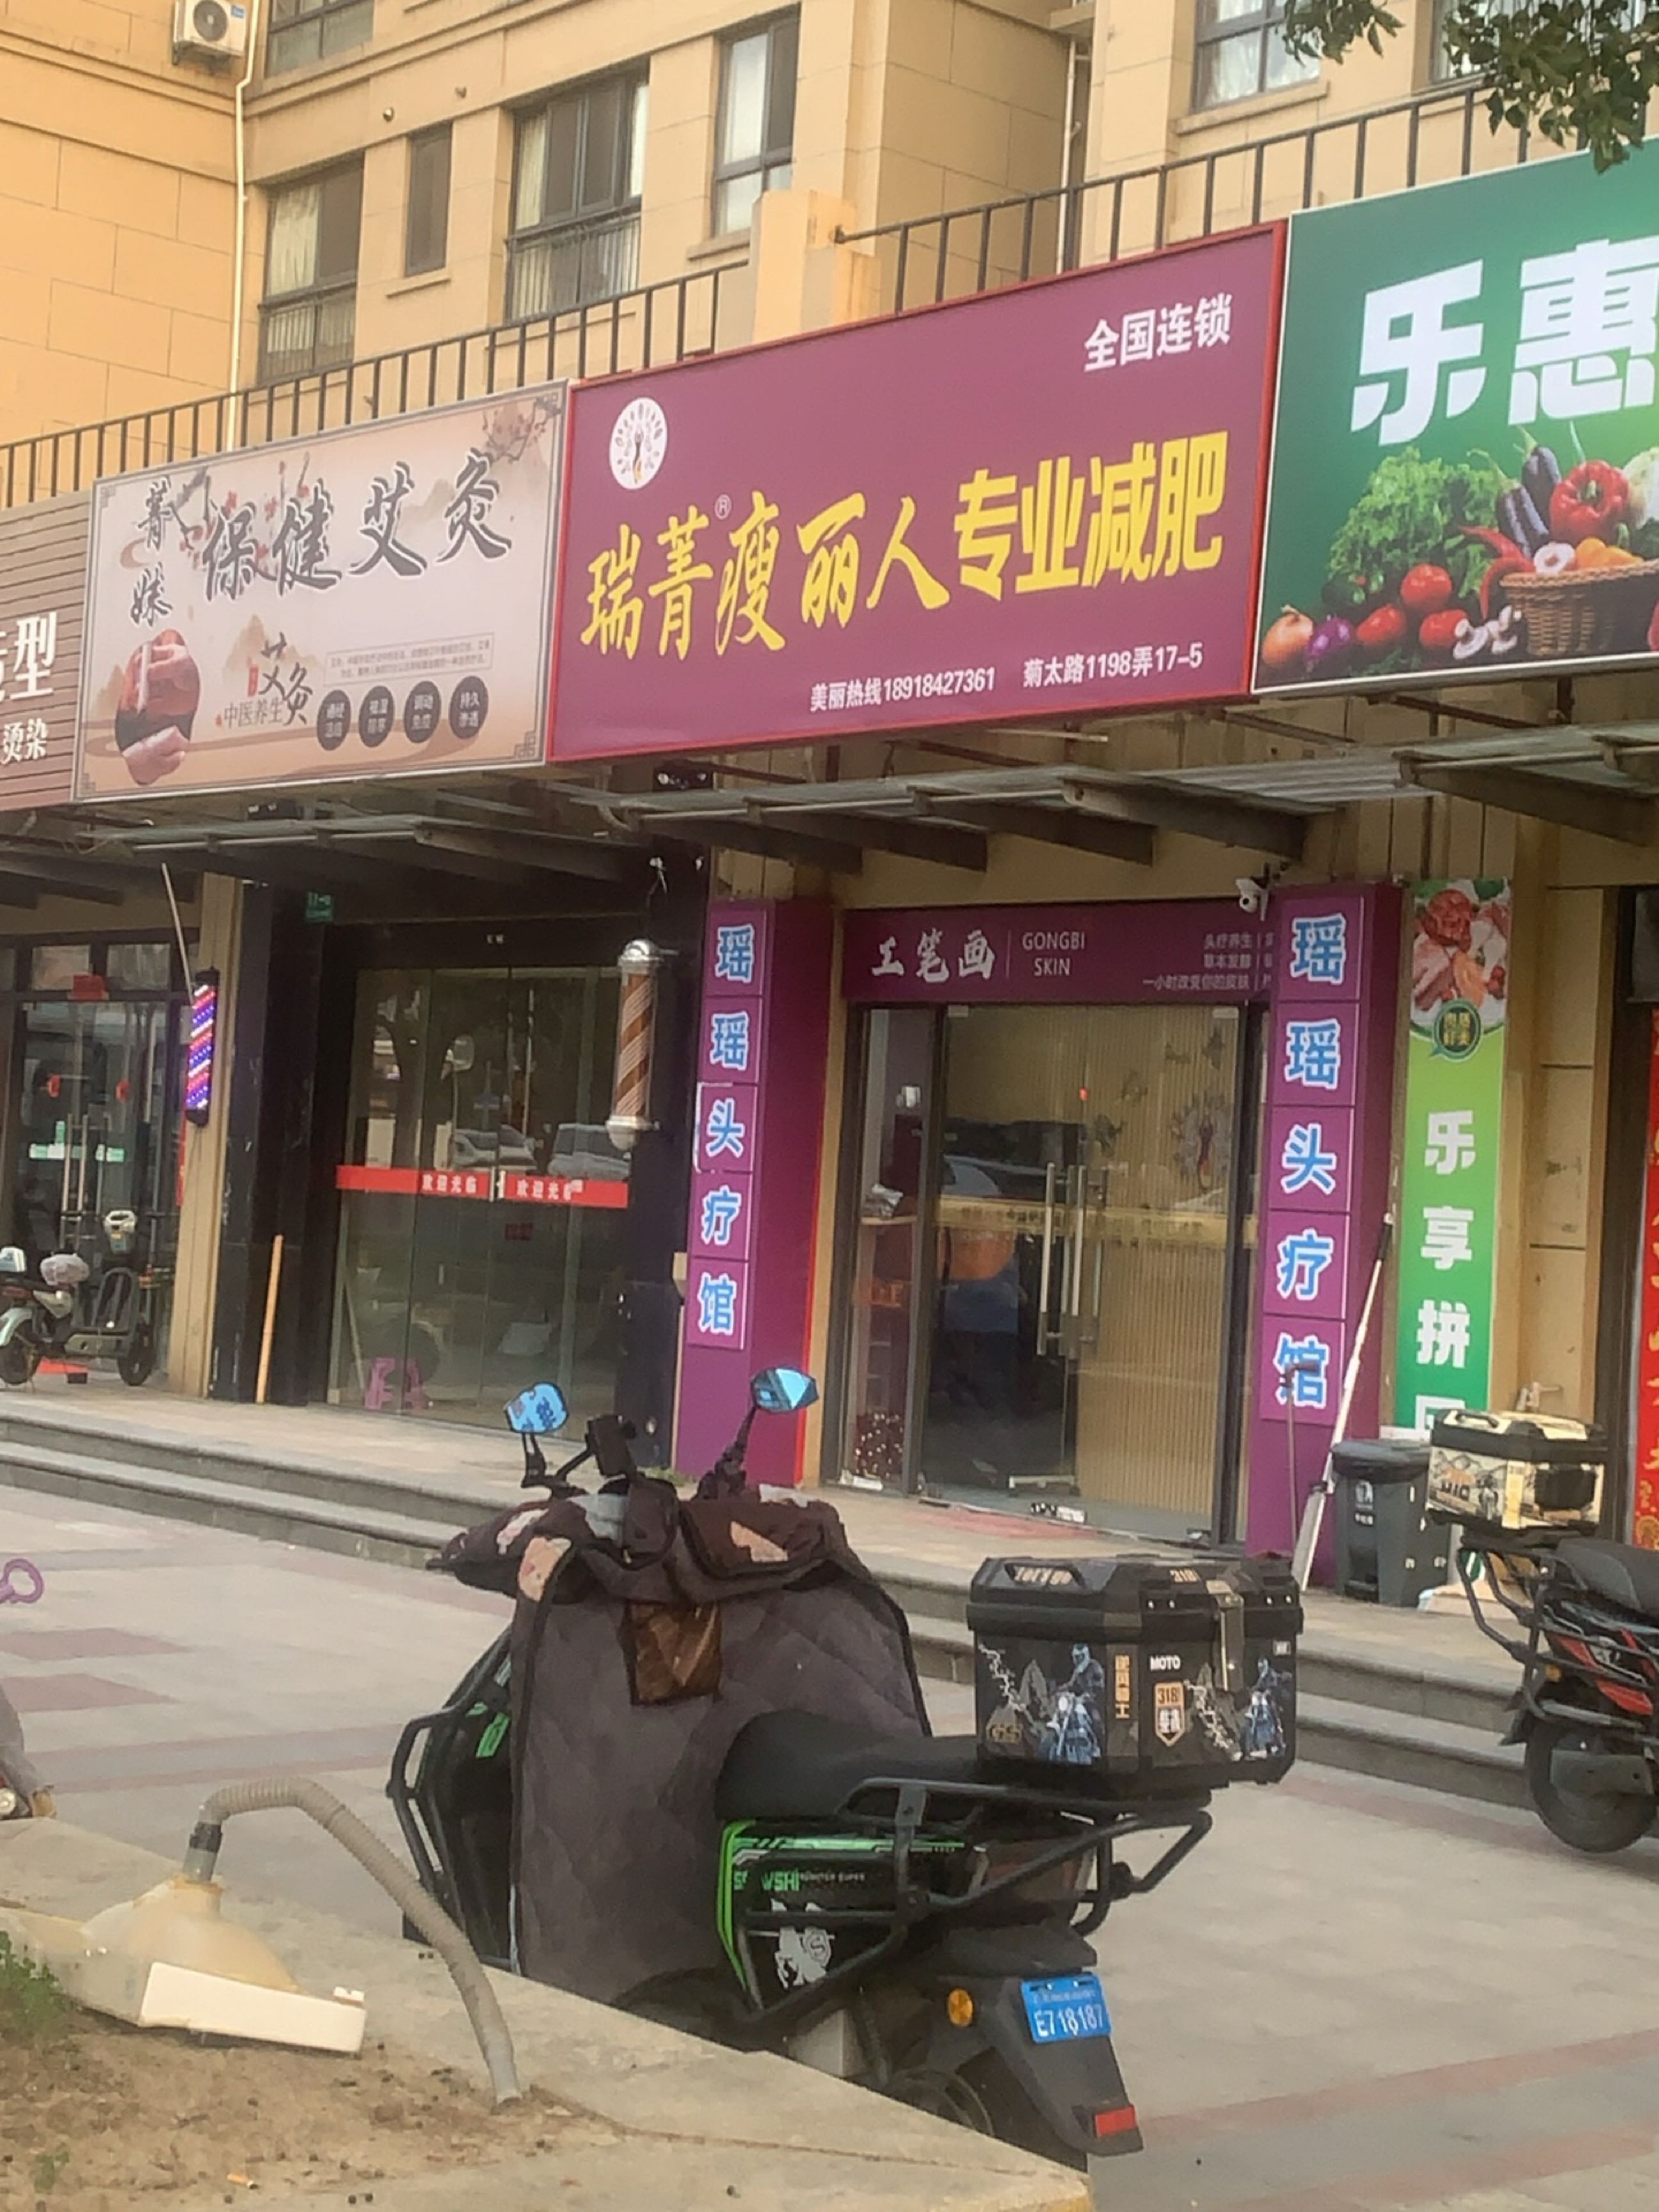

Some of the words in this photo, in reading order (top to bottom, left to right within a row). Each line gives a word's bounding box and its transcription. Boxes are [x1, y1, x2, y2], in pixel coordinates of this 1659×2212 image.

[1084, 293, 1232, 373] 全国连锁
[1350, 235, 1659, 446] 乐惠
[954, 431, 1228, 601] 专业减肥
[0, 611, 57, 701] 型
[810, 668, 995, 712] 美丽热线18918427361
[1023, 643, 1202, 688] 菊太路1198弄17-5
[1023, 932, 1085, 951] GONGBI
[1034, 958, 1070, 977] SKIN
[698, 924, 753, 1334] 瑶瑶头疗馆
[1273, 913, 1345, 1406] 瑶瑶头疗馆
[1150, 1655, 1181, 1671] MOTO
